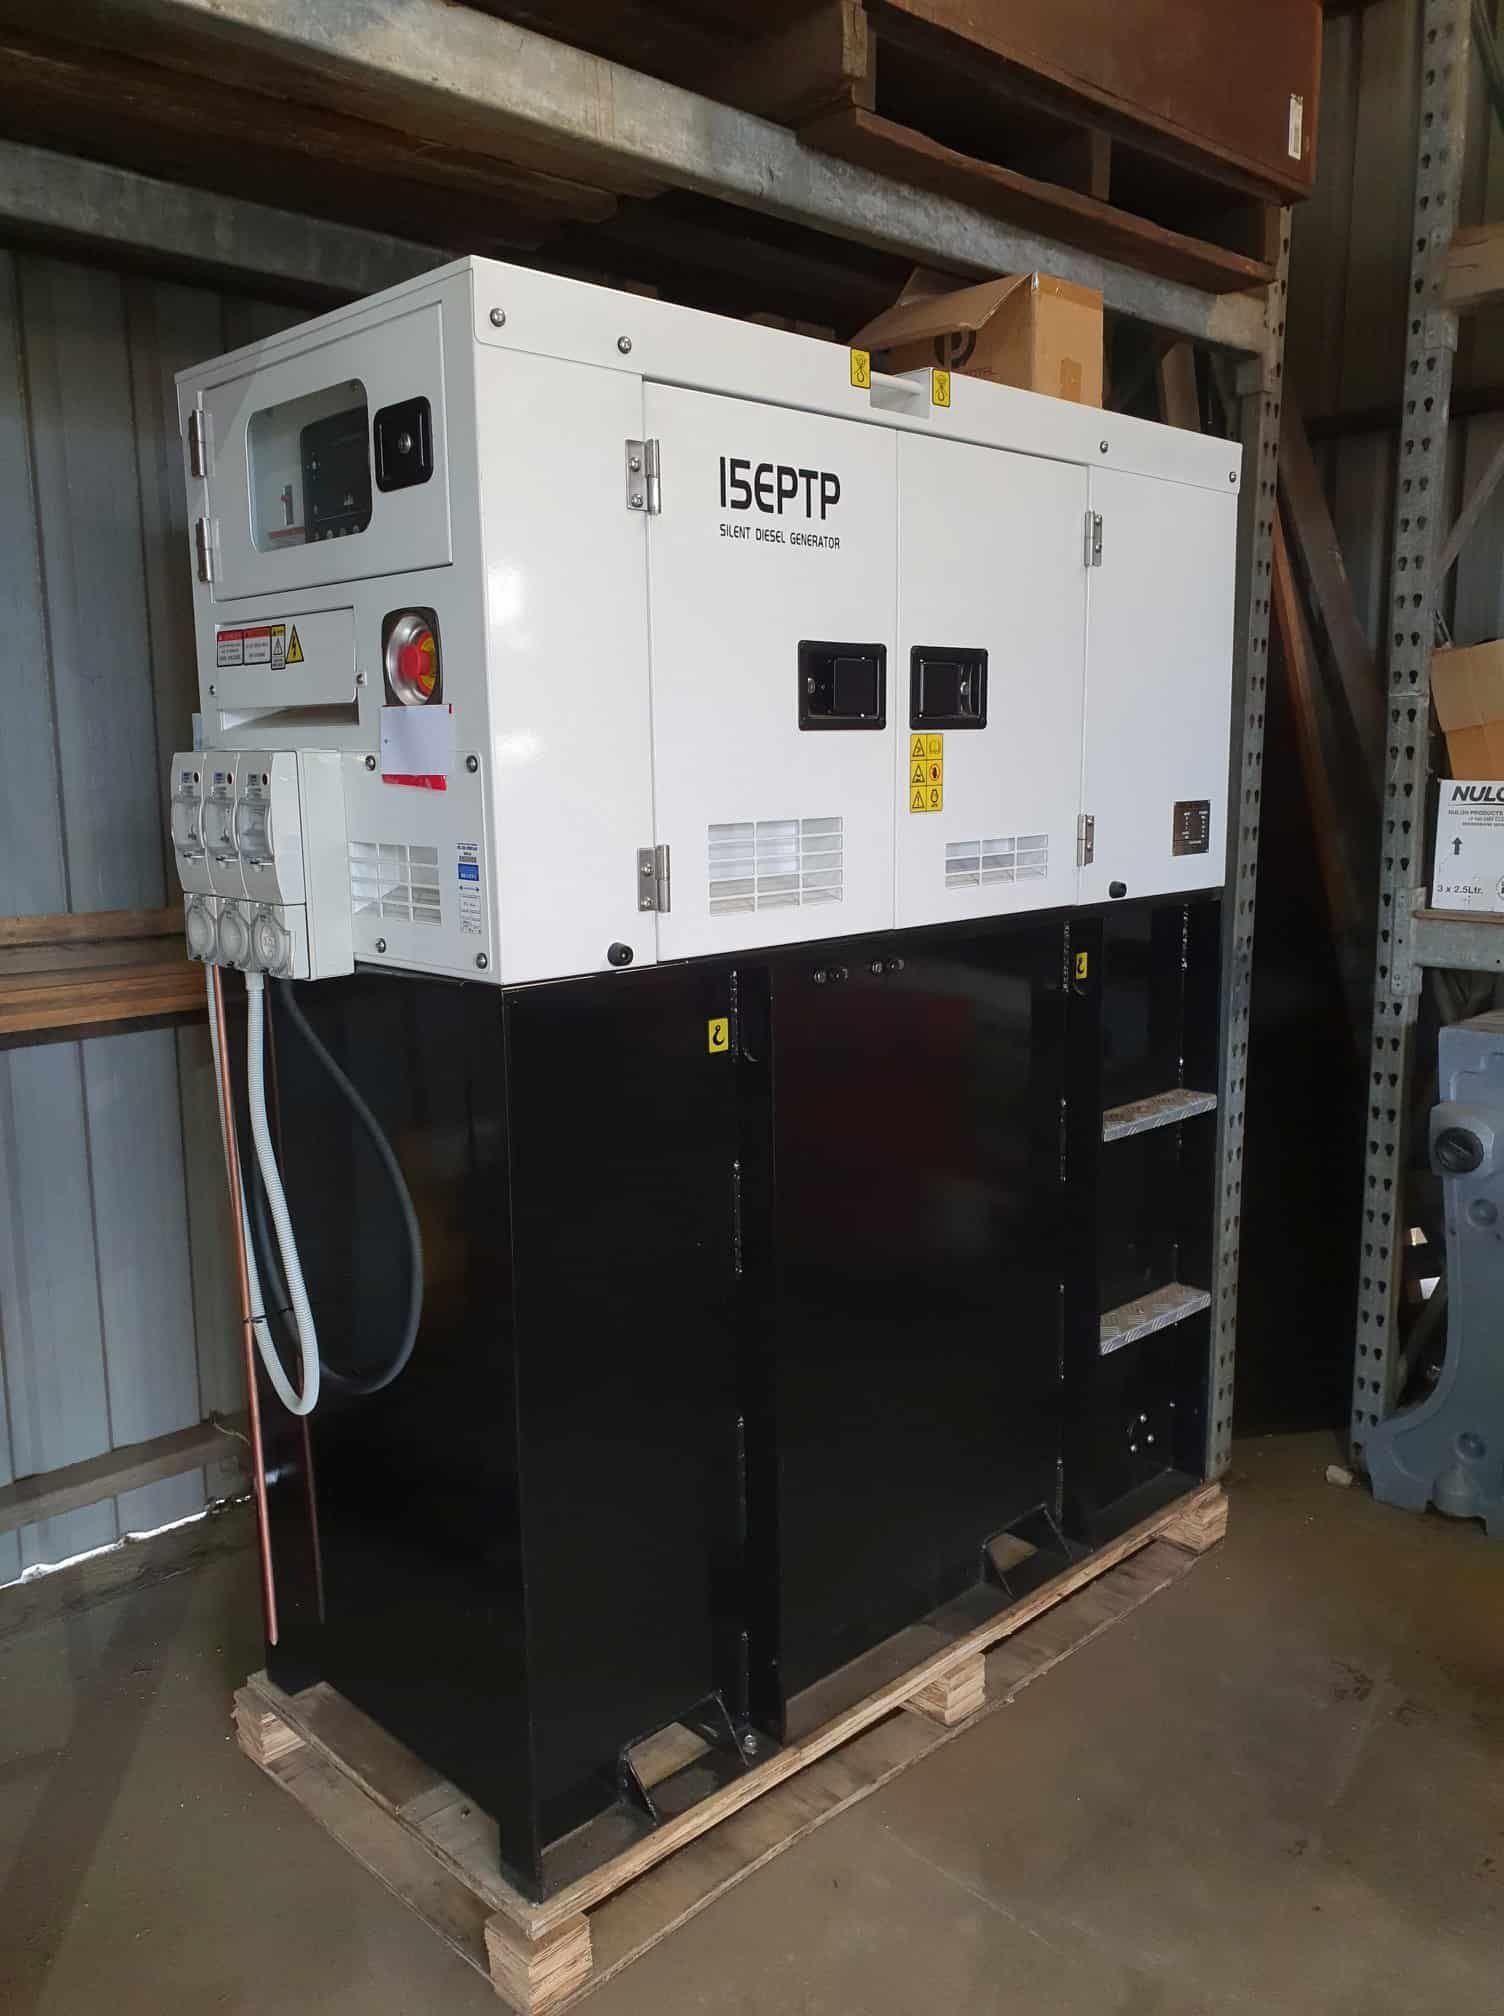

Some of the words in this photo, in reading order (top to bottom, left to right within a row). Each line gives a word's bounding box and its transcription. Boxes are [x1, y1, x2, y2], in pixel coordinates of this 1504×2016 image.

[720, 523, 751, 539] SILENT
[755, 528, 785, 543] DIESEL
[790, 532, 840, 550] GENERATOR
[1437, 884, 1444, 893] 3
